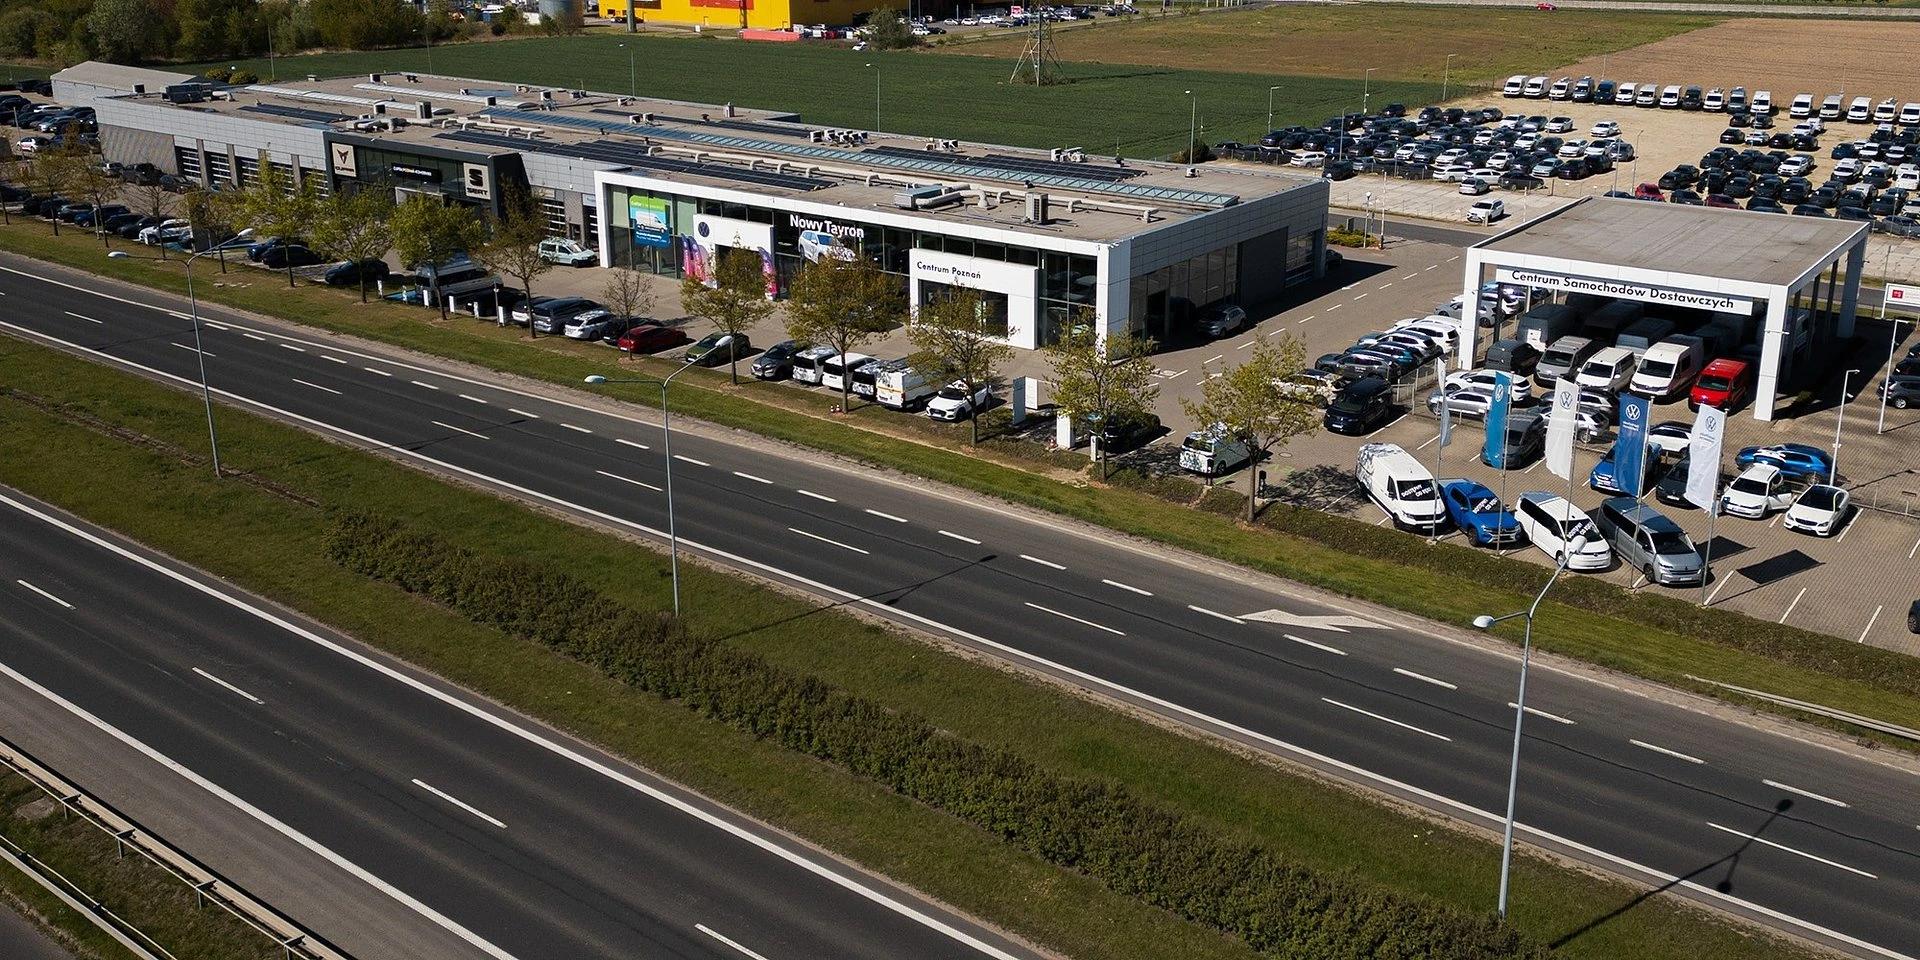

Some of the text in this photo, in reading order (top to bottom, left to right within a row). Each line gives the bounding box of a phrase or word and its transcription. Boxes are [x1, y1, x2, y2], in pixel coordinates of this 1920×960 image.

[789, 213, 865, 239] Nowy Tayron
[917, 261, 981, 279] Centrum Poznań
[1512, 270, 1734, 309] Centrum Samochodów Dostawczych
